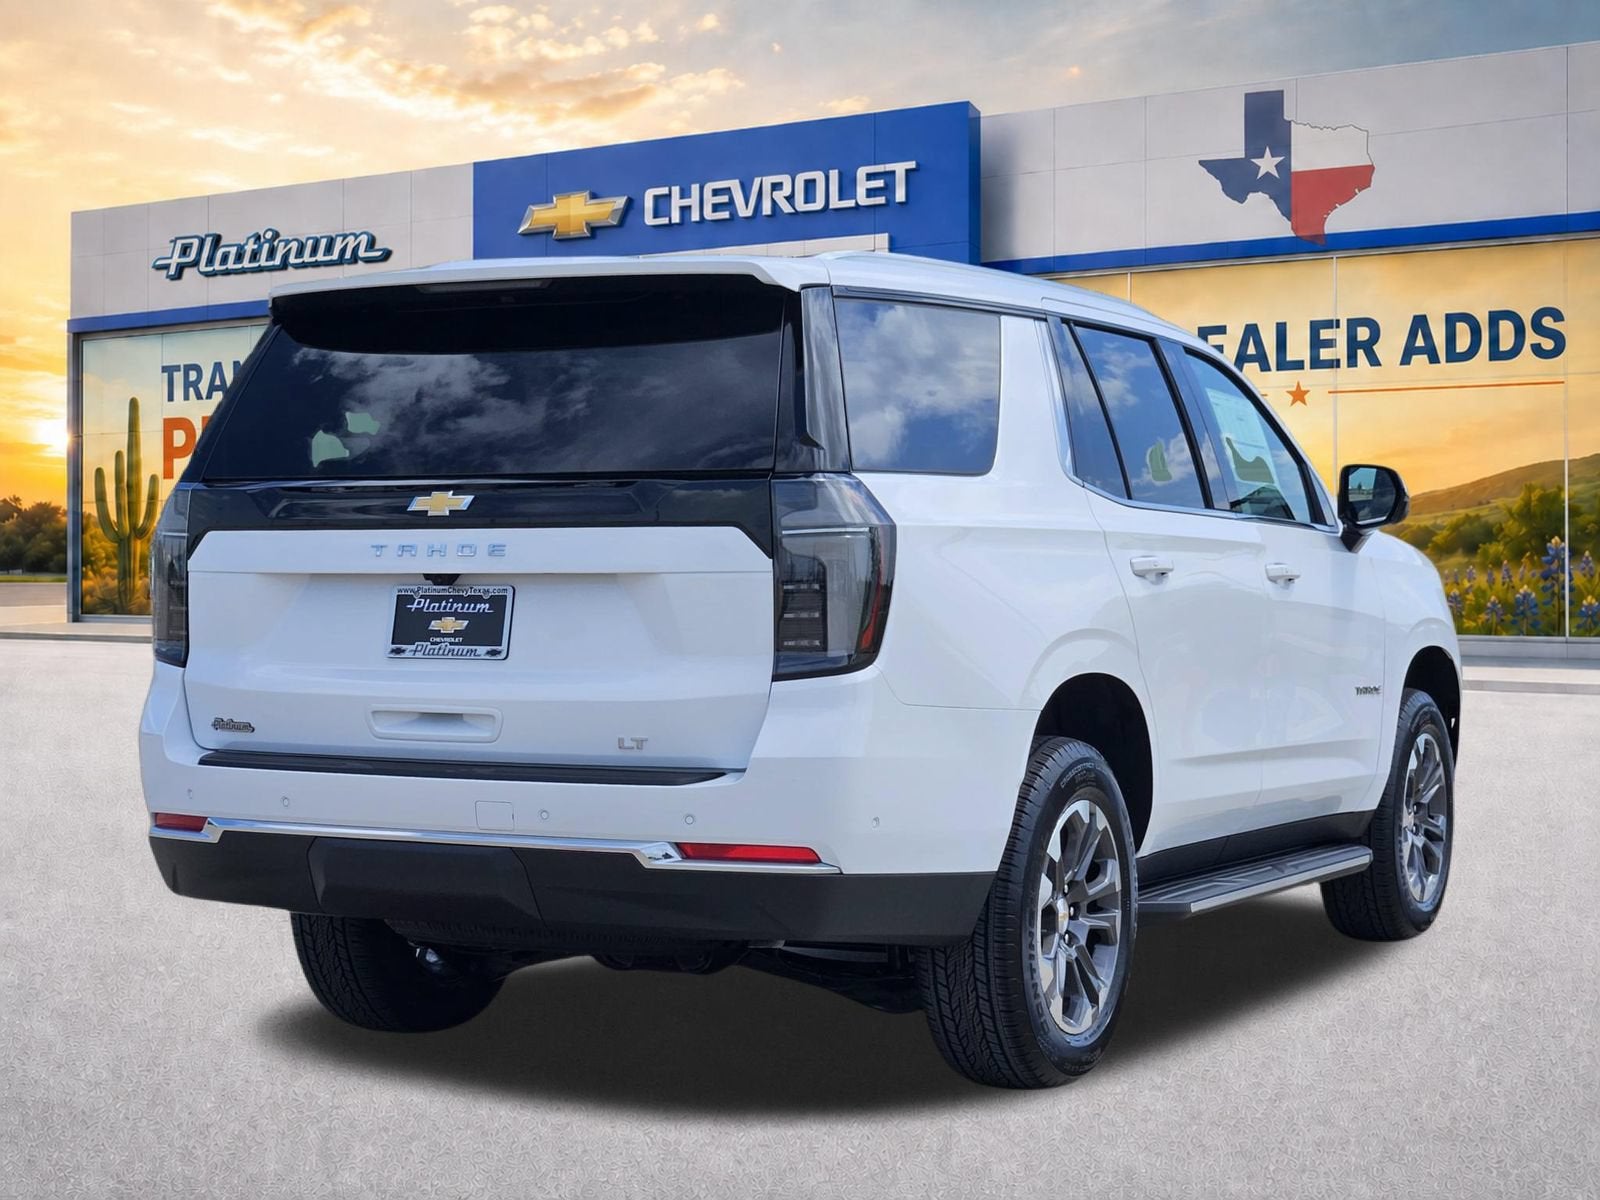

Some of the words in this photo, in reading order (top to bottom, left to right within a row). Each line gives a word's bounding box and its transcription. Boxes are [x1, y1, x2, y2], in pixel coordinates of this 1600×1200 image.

[643, 160, 918, 227] CHEVROLET
[152, 227, 392, 279] Platinum
[1399, 306, 1567, 366] ADDS
[161, 360, 243, 402] TRA
[370, 543, 507, 558] TAHOE
[397, 586, 509, 596] www.PlatinumChevyTexas.com
[406, 598, 495, 613] Platinum
[408, 642, 482, 657] Platinum
[617, 736, 649, 750] LT
